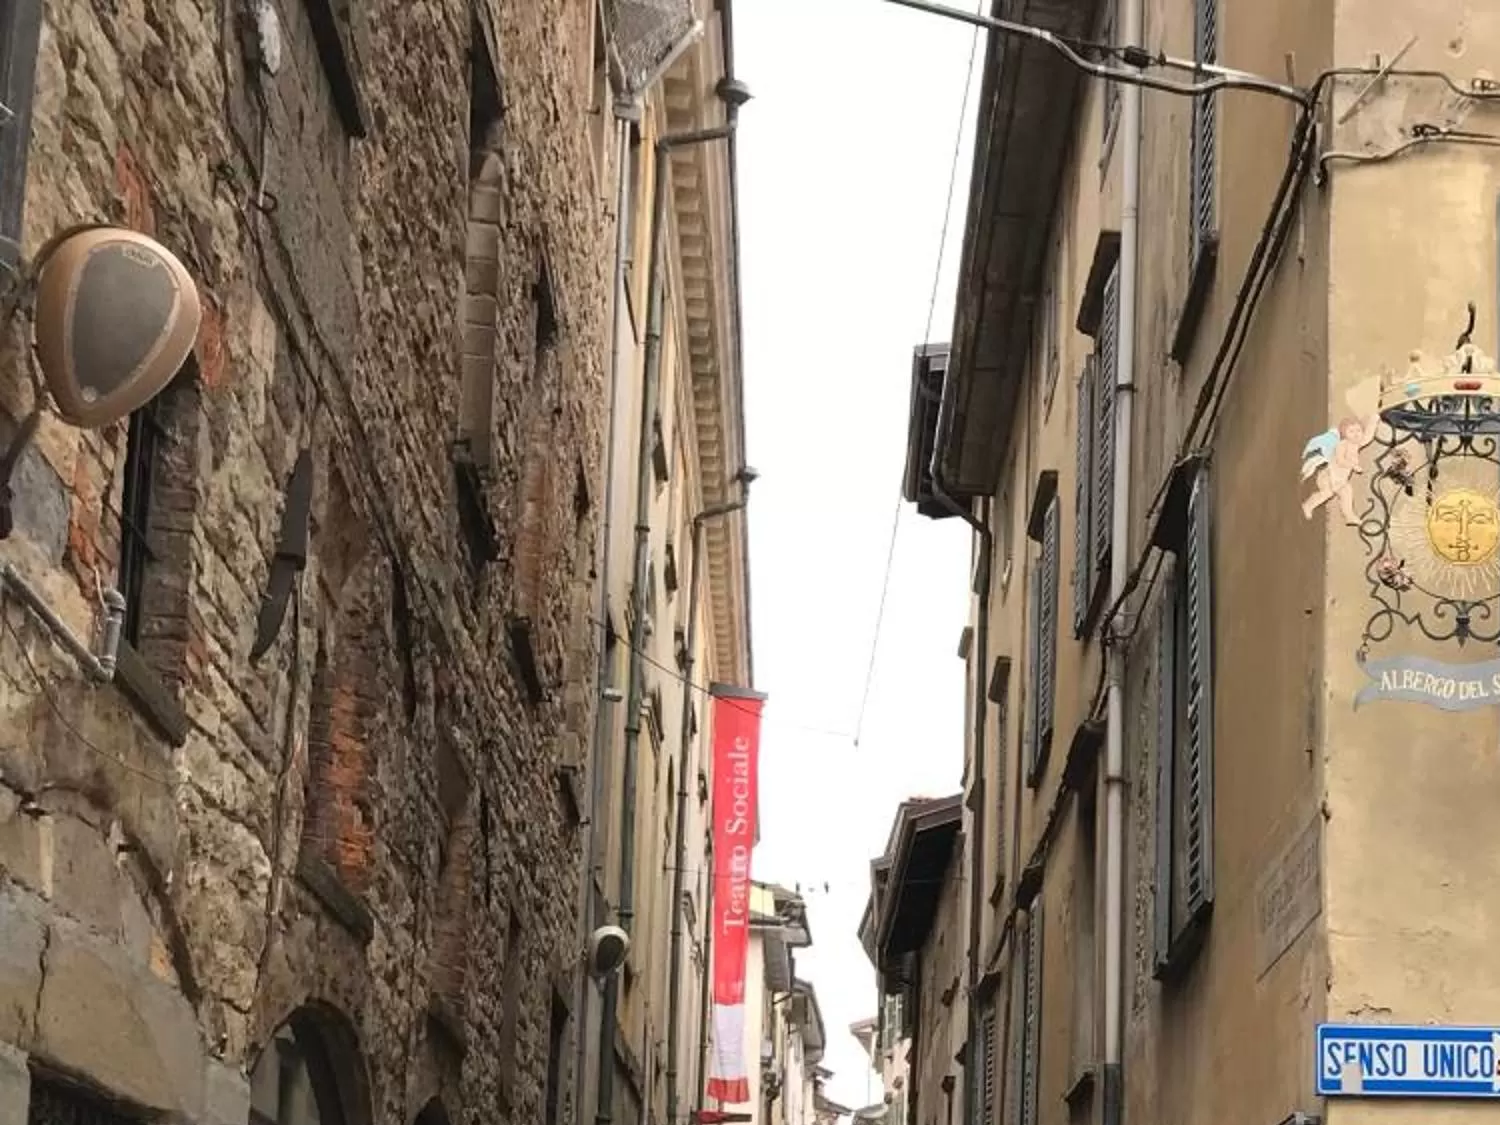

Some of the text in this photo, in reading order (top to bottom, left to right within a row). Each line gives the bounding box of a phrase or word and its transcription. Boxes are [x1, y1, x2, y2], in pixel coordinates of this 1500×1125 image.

[1380, 668, 1455, 700] ALBERGO
[1458, 680, 1489, 701] DEL
[724, 735, 751, 836] Sociale
[1326, 1041, 1408, 1078] SENSO
[1423, 1043, 1494, 1079] UNICO
